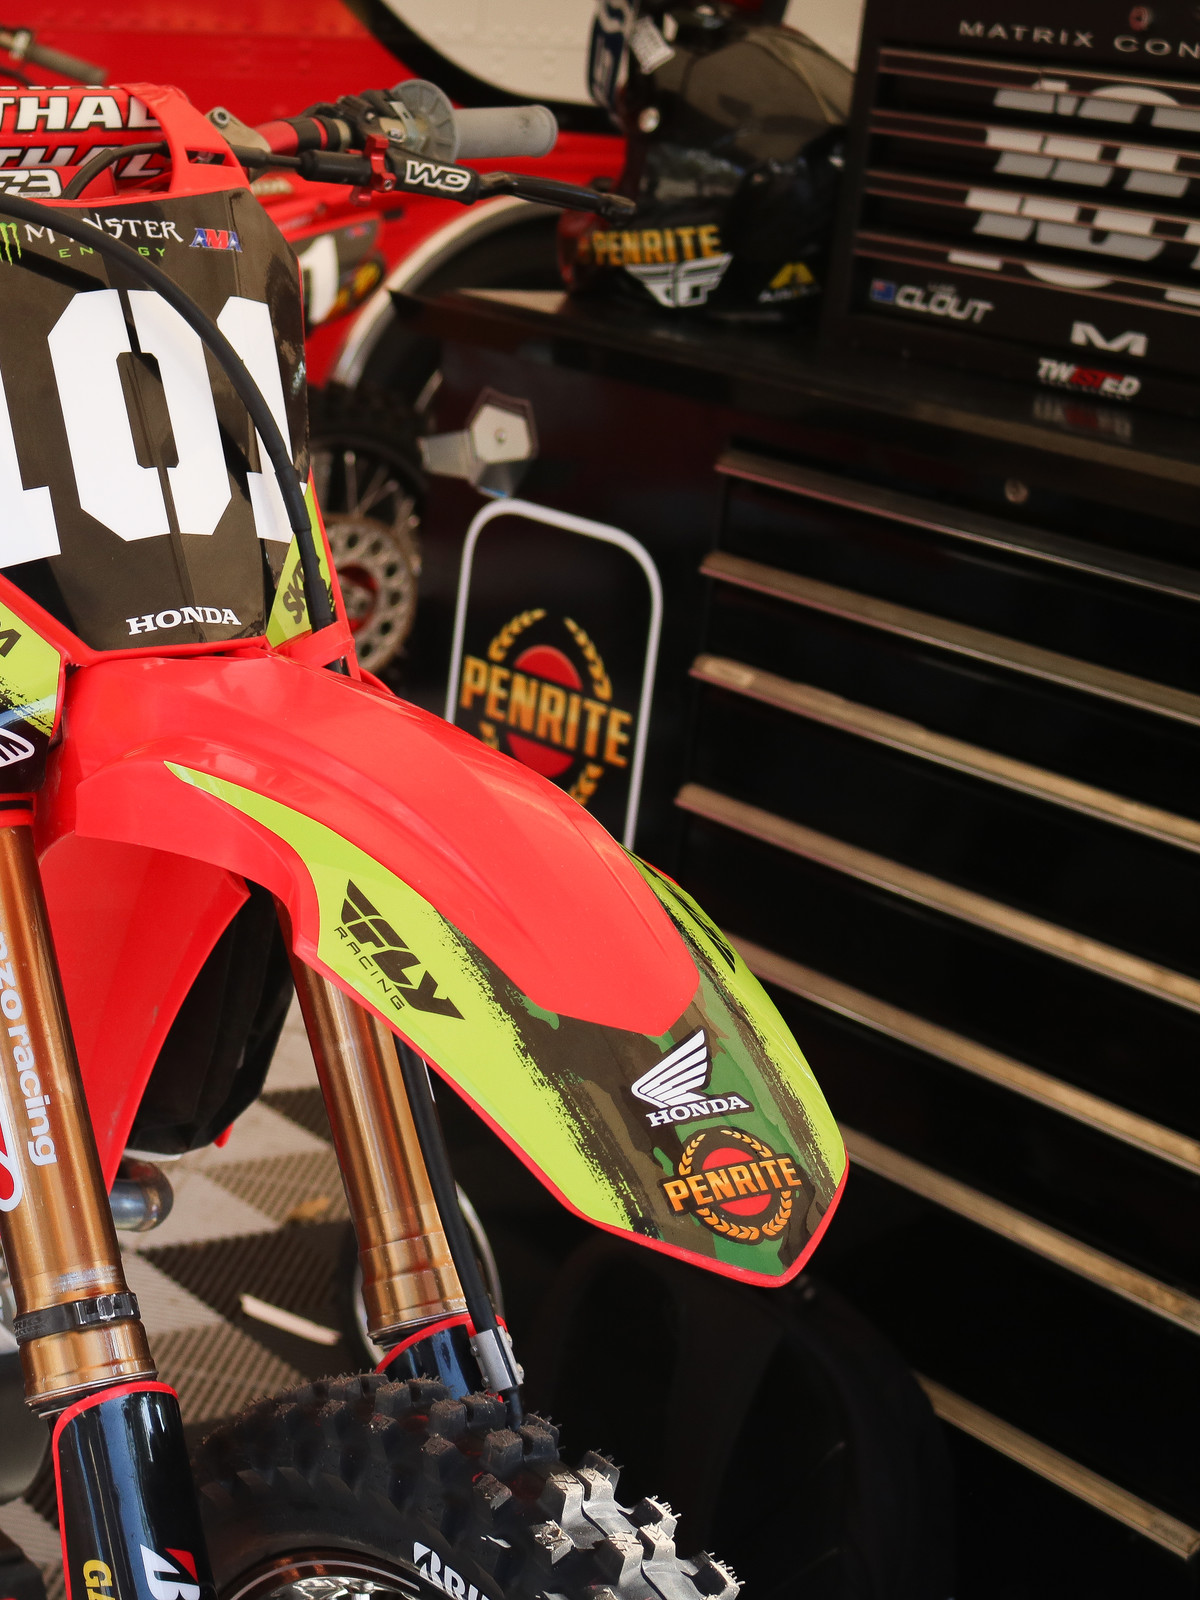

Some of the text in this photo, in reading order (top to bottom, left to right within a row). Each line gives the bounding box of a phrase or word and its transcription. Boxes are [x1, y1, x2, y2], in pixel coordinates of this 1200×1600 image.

[959, 20, 1093, 48] MATRIX
[24, 213, 184, 244] MNSTER
[189, 227, 243, 253] AMA
[592, 225, 723, 266] PENRITE
[59, 246, 166, 258] ENGY
[895, 285, 994, 323] CLOUT
[126, 606, 243, 636] HONDA
[461, 655, 632, 768] PENRITE
[341, 878, 466, 1021] FLY
[334, 926, 405, 1011] RACING
[646, 1095, 750, 1128] HONDA
[663, 1157, 802, 1212] PENRITE
